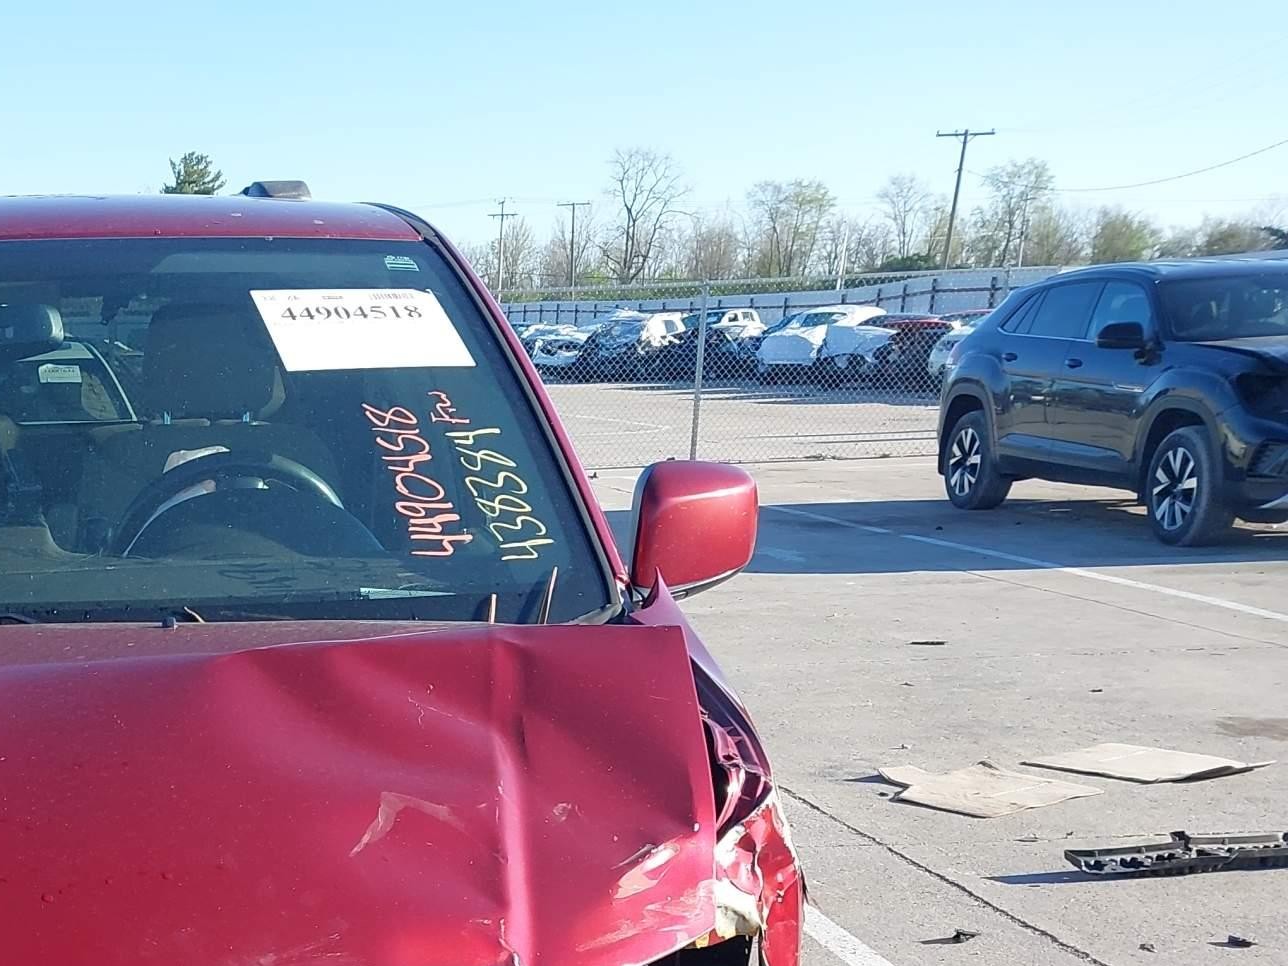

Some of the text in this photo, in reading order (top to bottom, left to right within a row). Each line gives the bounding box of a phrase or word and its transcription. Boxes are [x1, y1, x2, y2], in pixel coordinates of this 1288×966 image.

[280, 303, 423, 322] 44904518
[361, 402, 474, 557] 44904518
[444, 427, 555, 562] 438384
